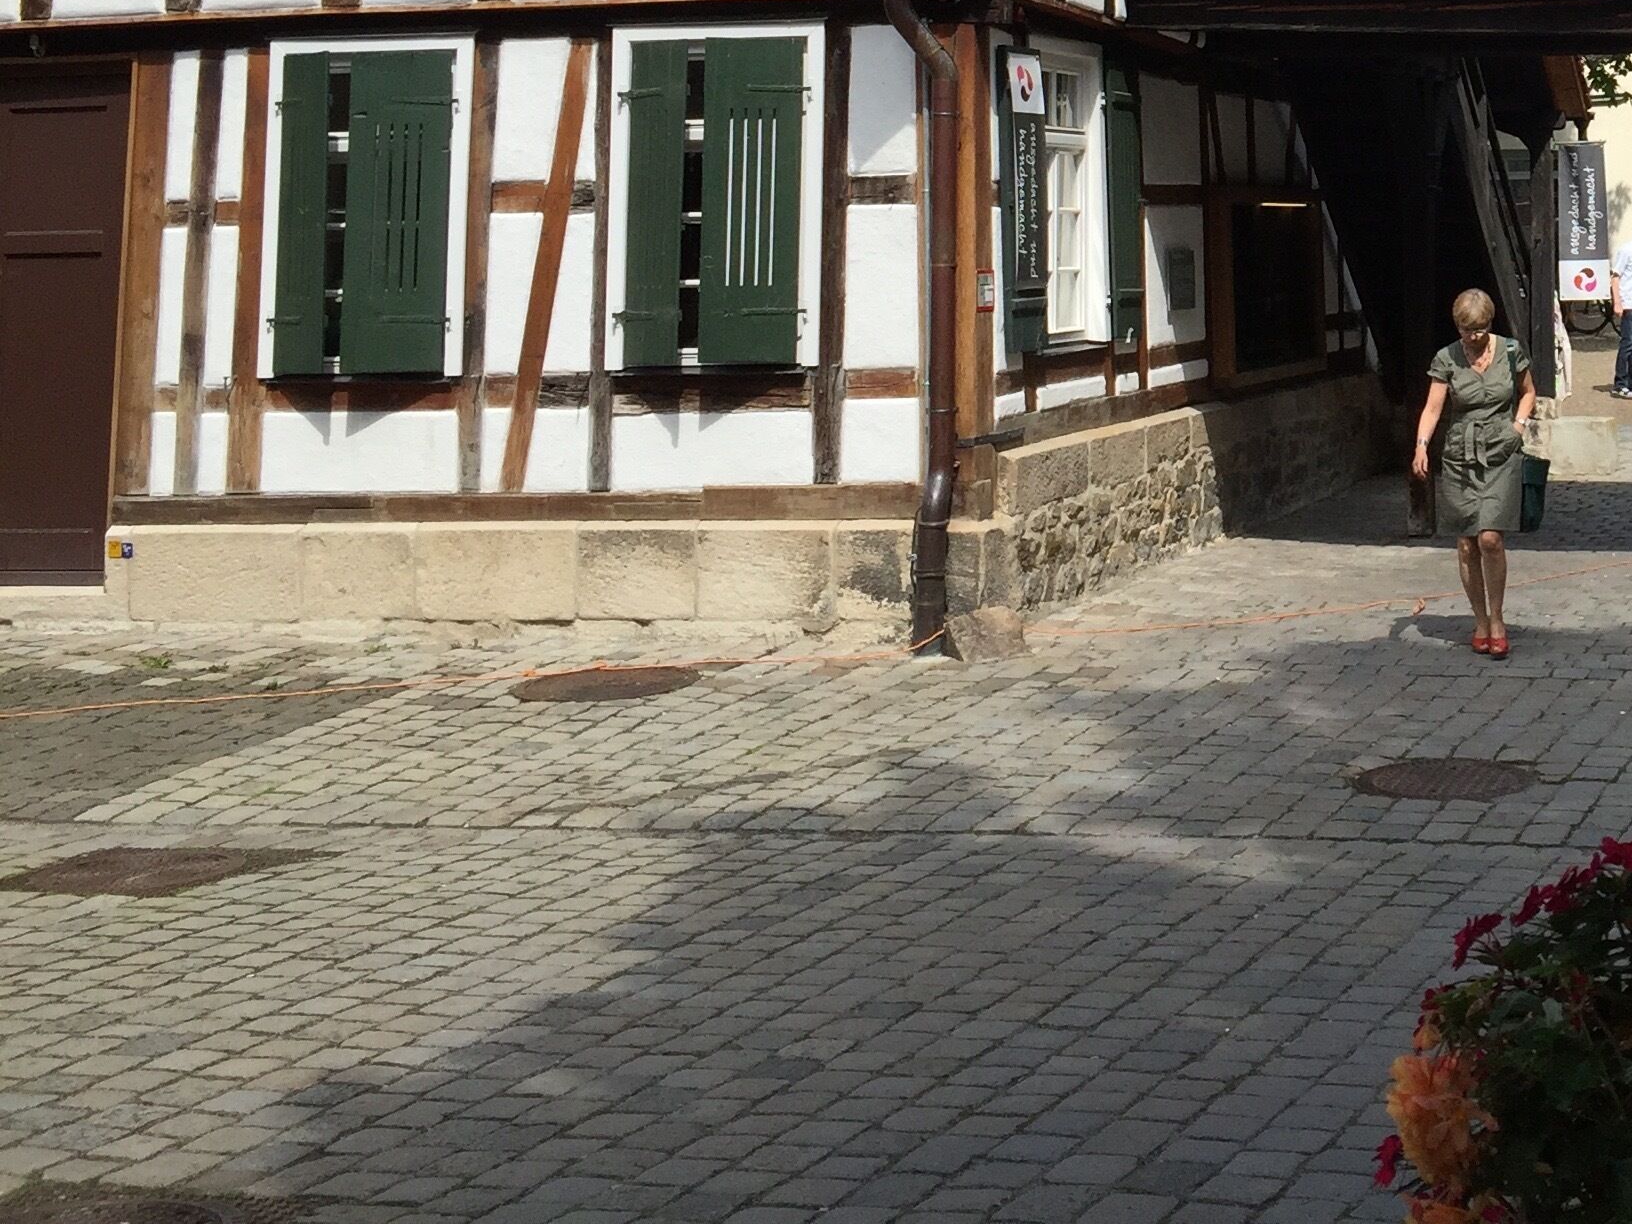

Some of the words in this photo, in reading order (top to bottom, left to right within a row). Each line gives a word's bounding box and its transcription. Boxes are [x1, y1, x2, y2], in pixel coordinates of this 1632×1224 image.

[1016, 128, 1027, 258] handgemacht
[1025, 122, 1039, 232] ausgedacht
[1569, 152, 1581, 178] und
[1568, 184, 1587, 255] ausgedacht
[1583, 165, 1604, 251] handgemacht
[1030, 240, 1039, 279] und
